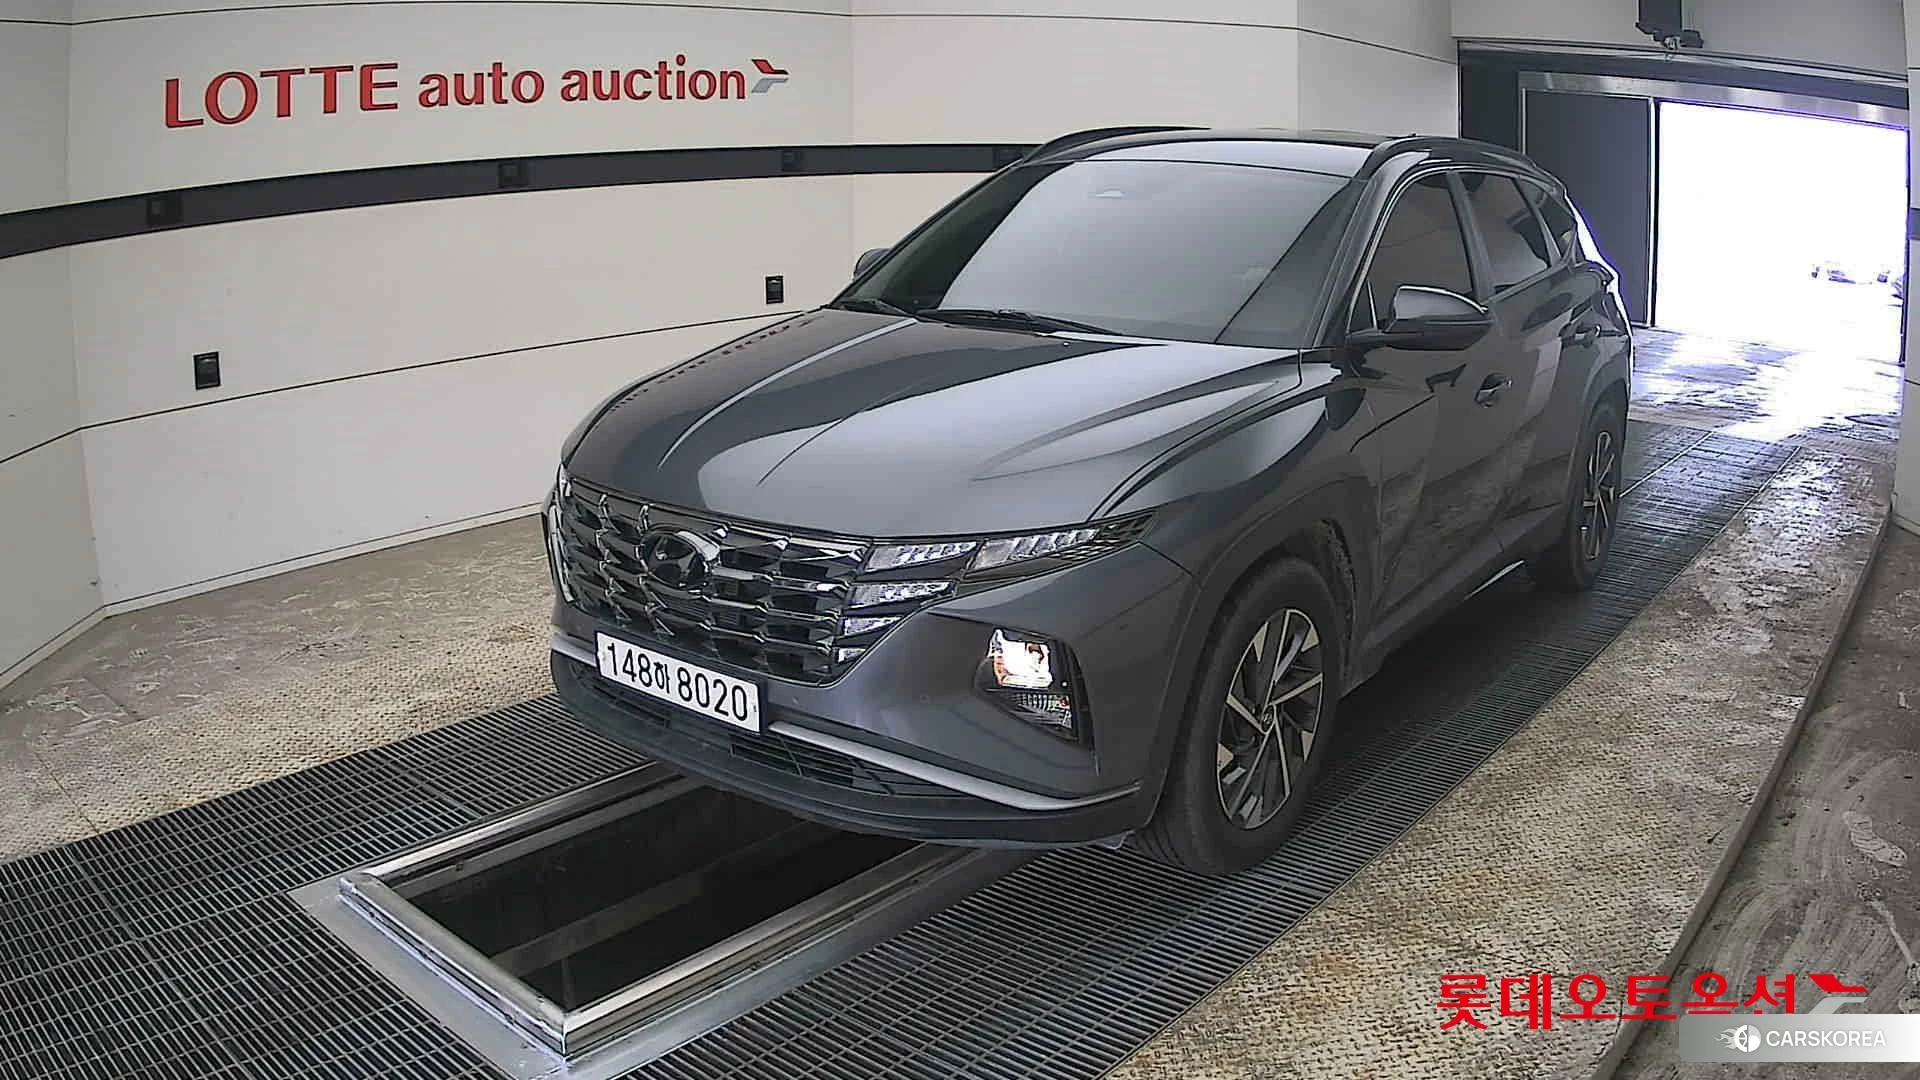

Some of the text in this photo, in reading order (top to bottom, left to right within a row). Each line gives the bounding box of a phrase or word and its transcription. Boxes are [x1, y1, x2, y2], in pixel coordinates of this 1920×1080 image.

[165, 53, 747, 129] LOTTE auto auction
[607, 642, 748, 721] 148하 8020
